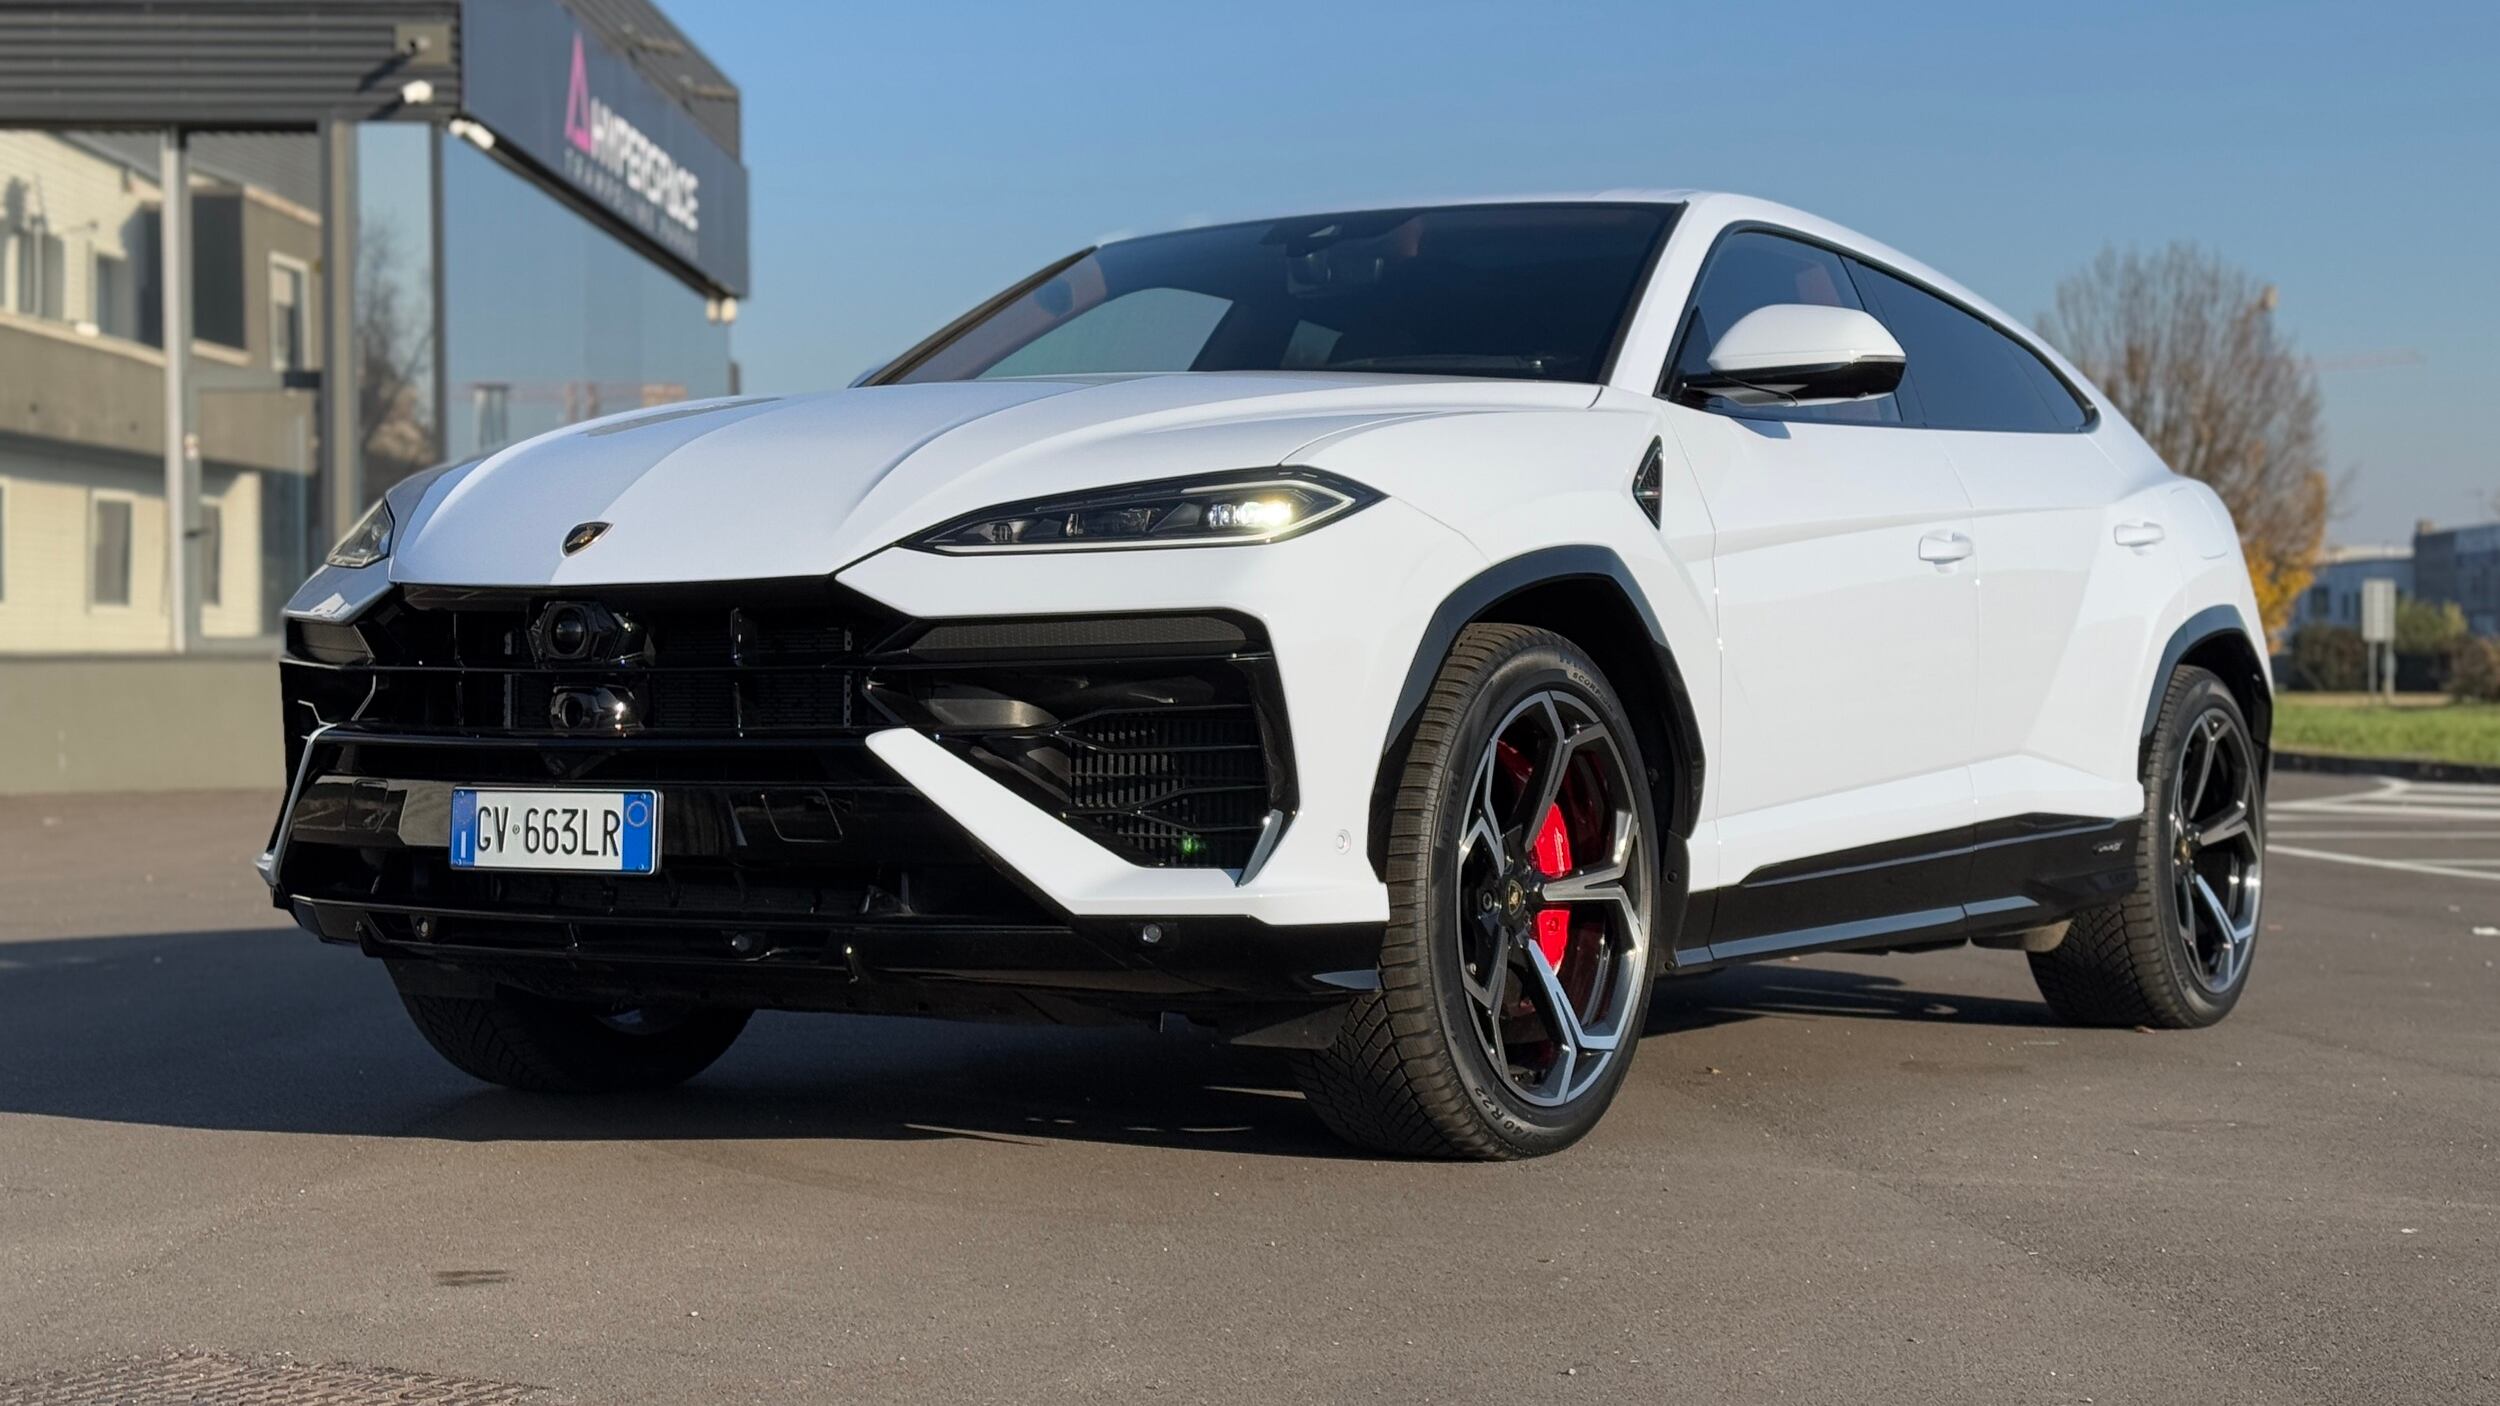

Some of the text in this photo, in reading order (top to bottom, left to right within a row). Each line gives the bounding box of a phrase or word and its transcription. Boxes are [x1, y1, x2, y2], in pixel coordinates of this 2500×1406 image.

[1572, 671, 1613, 712] SCORPION
[477, 806, 621, 857] GV 663LR
